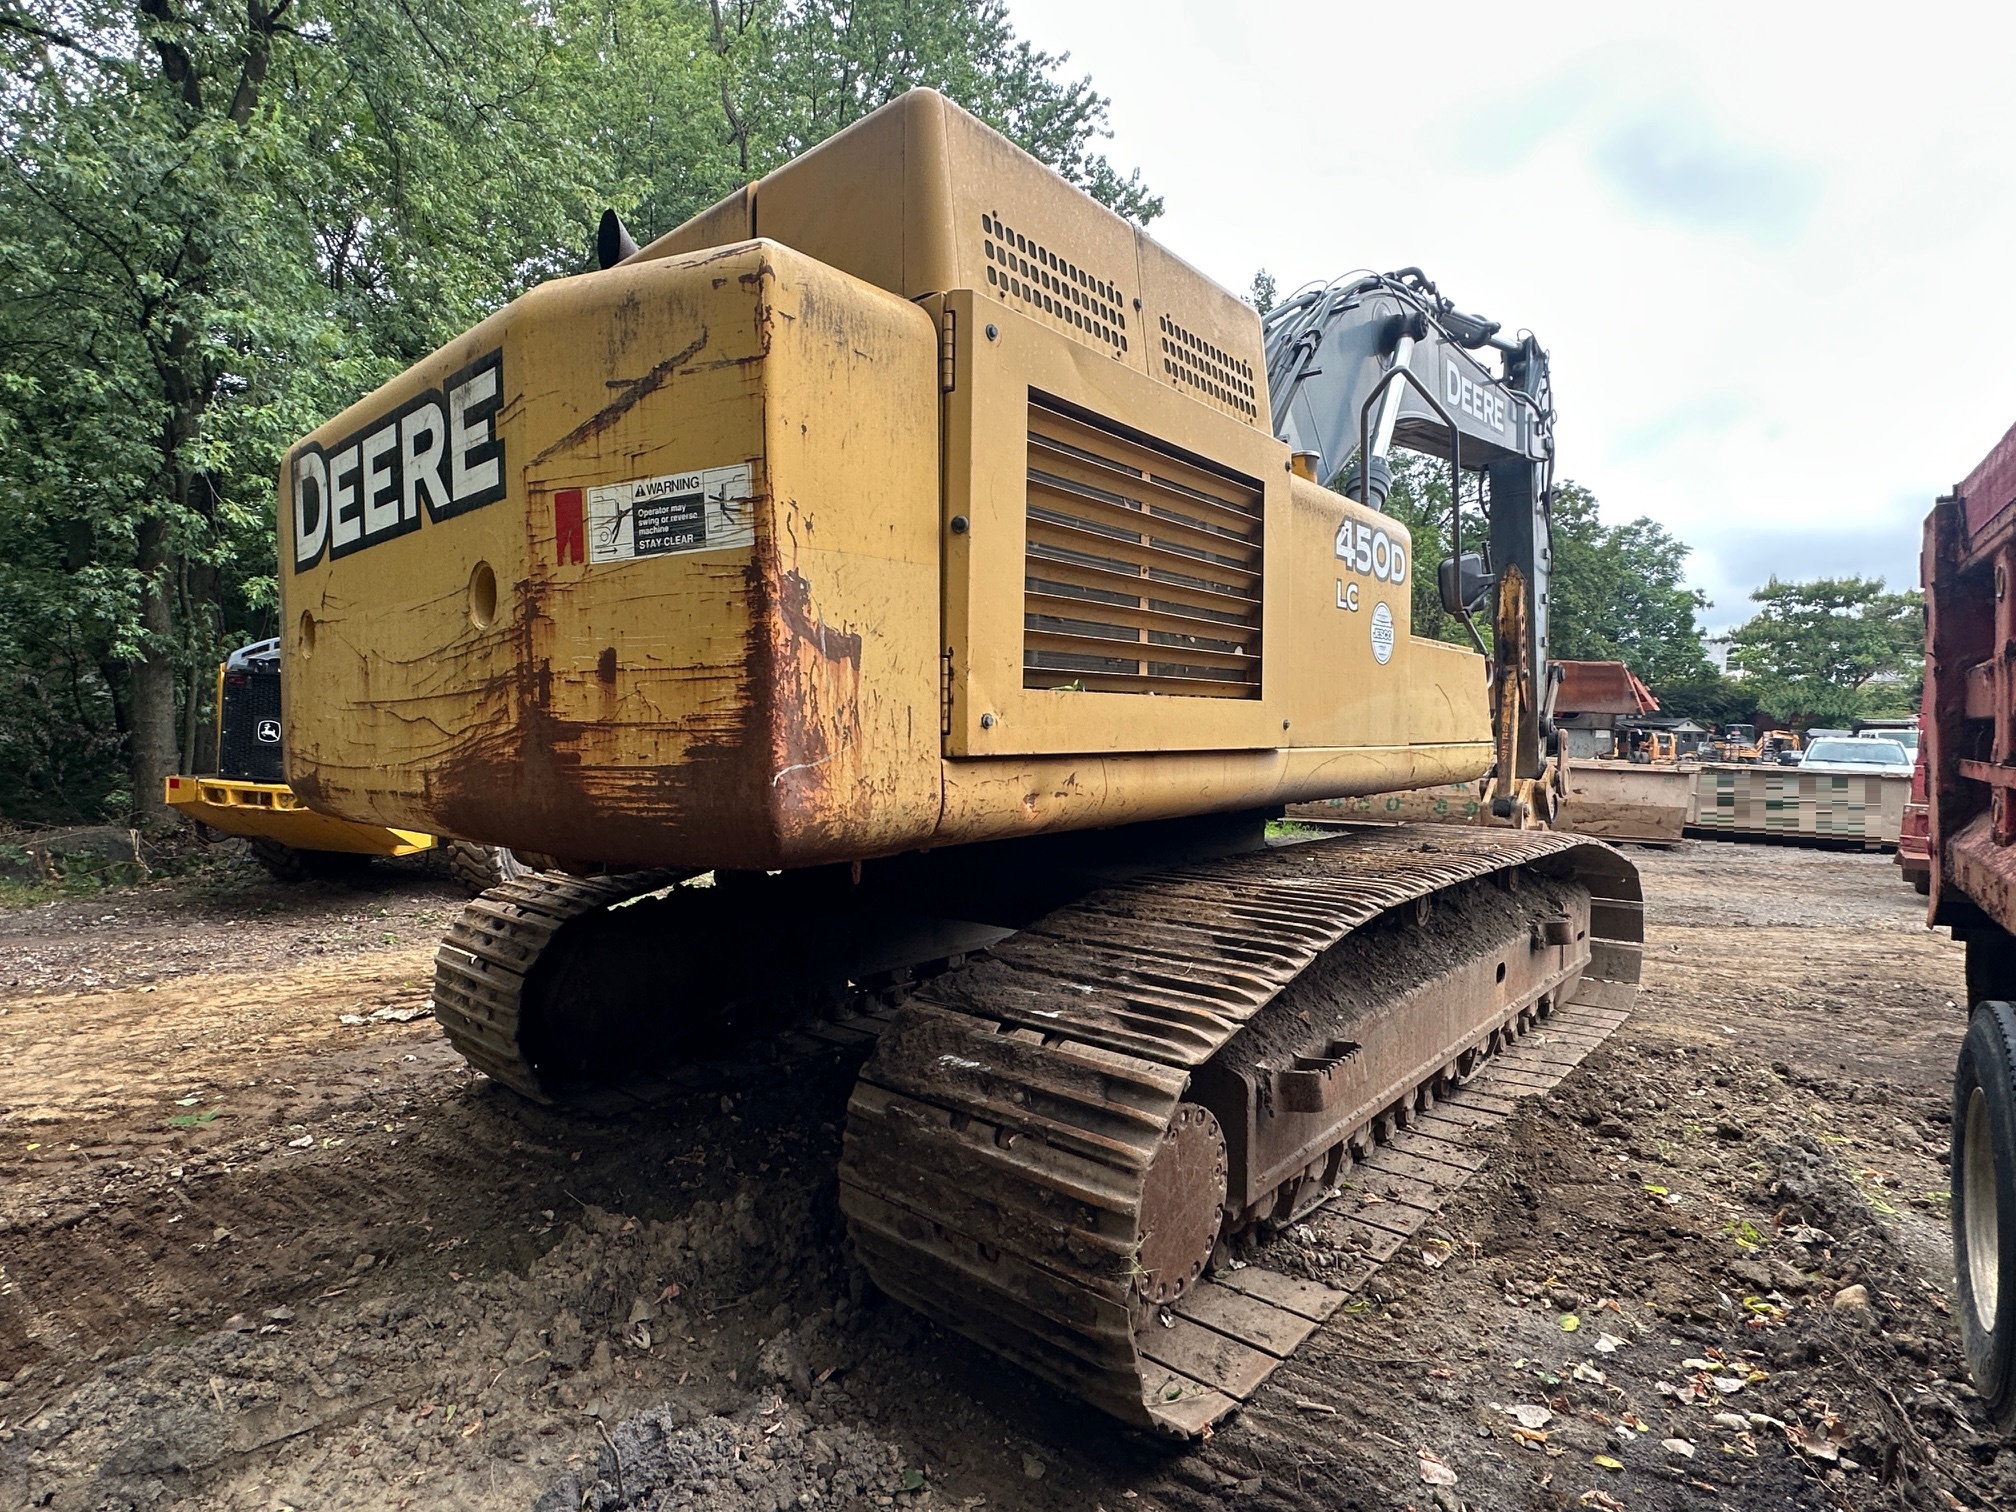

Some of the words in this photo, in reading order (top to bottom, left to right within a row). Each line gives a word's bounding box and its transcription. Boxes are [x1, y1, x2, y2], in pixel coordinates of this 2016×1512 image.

[1447, 358, 1504, 433] DEERE
[293, 365, 499, 563] DEERE
[646, 476, 699, 495] WARNING
[637, 506, 669, 518] Operator
[670, 504, 687, 513] may
[638, 517, 660, 526] swing
[670, 512, 698, 522] reverse
[638, 525, 669, 535] machine
[639, 537, 662, 549] STAY
[663, 534, 694, 546] CLEAR
[1336, 519, 1406, 583] 450D
[1336, 580, 1359, 611] LC
[1373, 627, 1393, 641] JESCO
